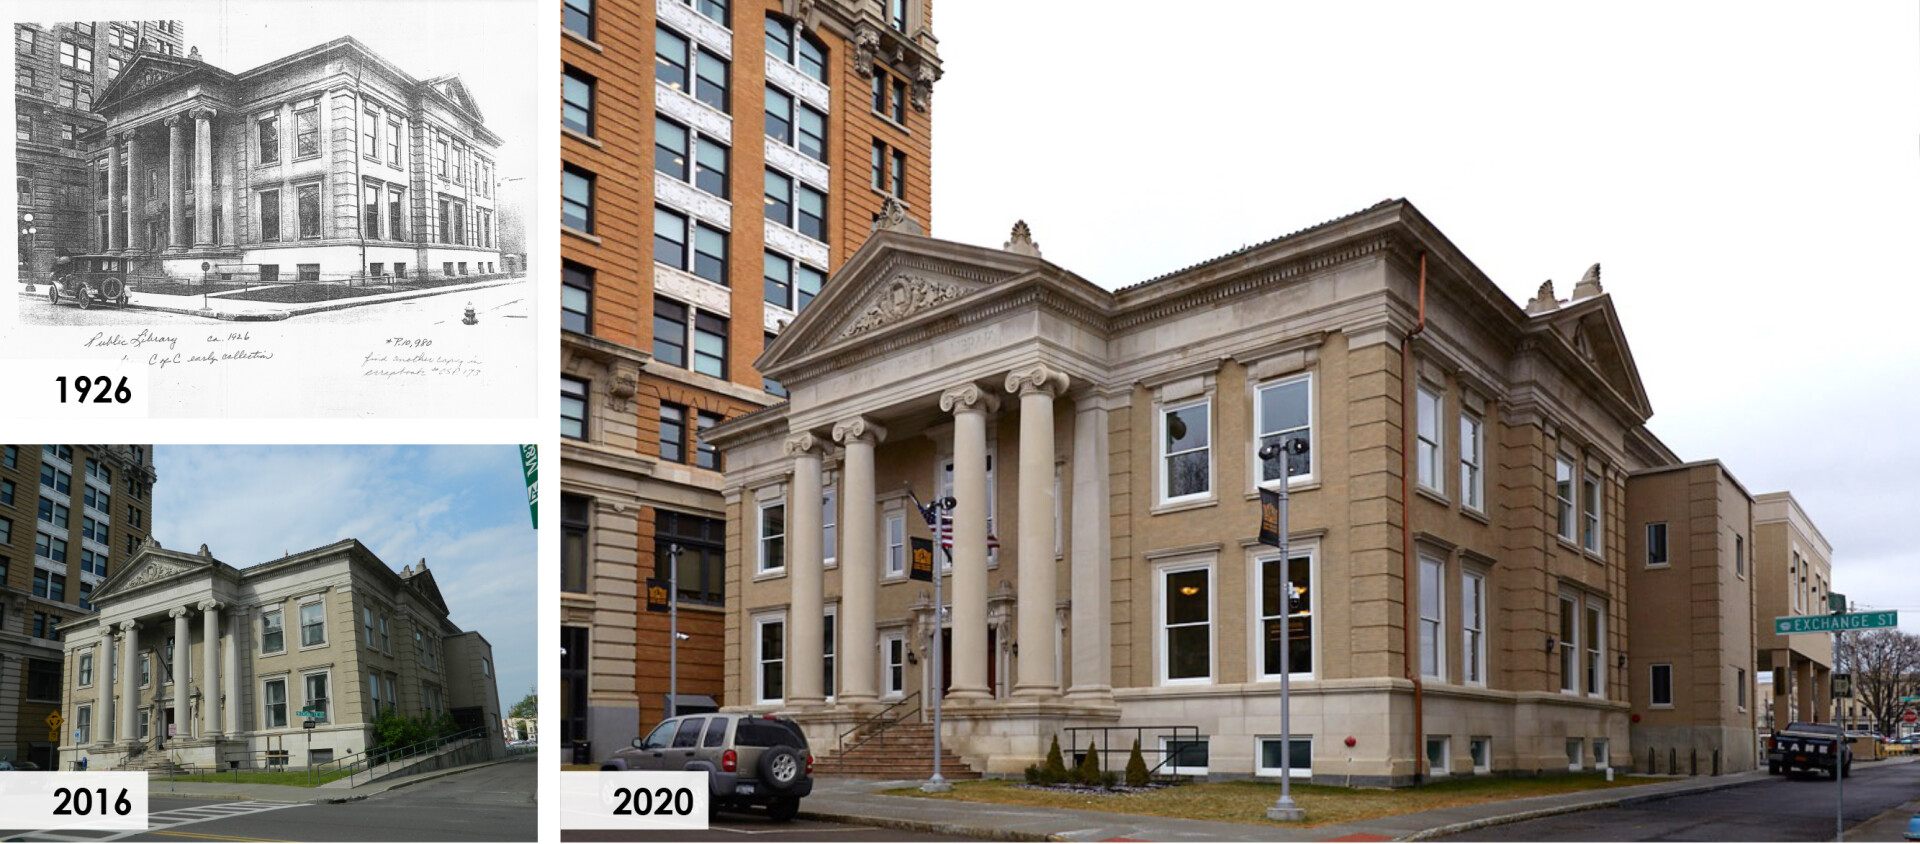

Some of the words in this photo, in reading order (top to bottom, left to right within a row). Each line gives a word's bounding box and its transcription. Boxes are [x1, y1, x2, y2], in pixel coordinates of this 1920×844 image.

[84, 332, 128, 347] Public
[130, 329, 178, 350] Library
[228, 331, 250, 341] 1926
[149, 354, 158, 365] C
[173, 353, 181, 364] C
[187, 352, 218, 364] early
[222, 350, 273, 360] collection
[1794, 614, 1868, 631] EXCHANGE
[1878, 613, 1895, 626] ST
